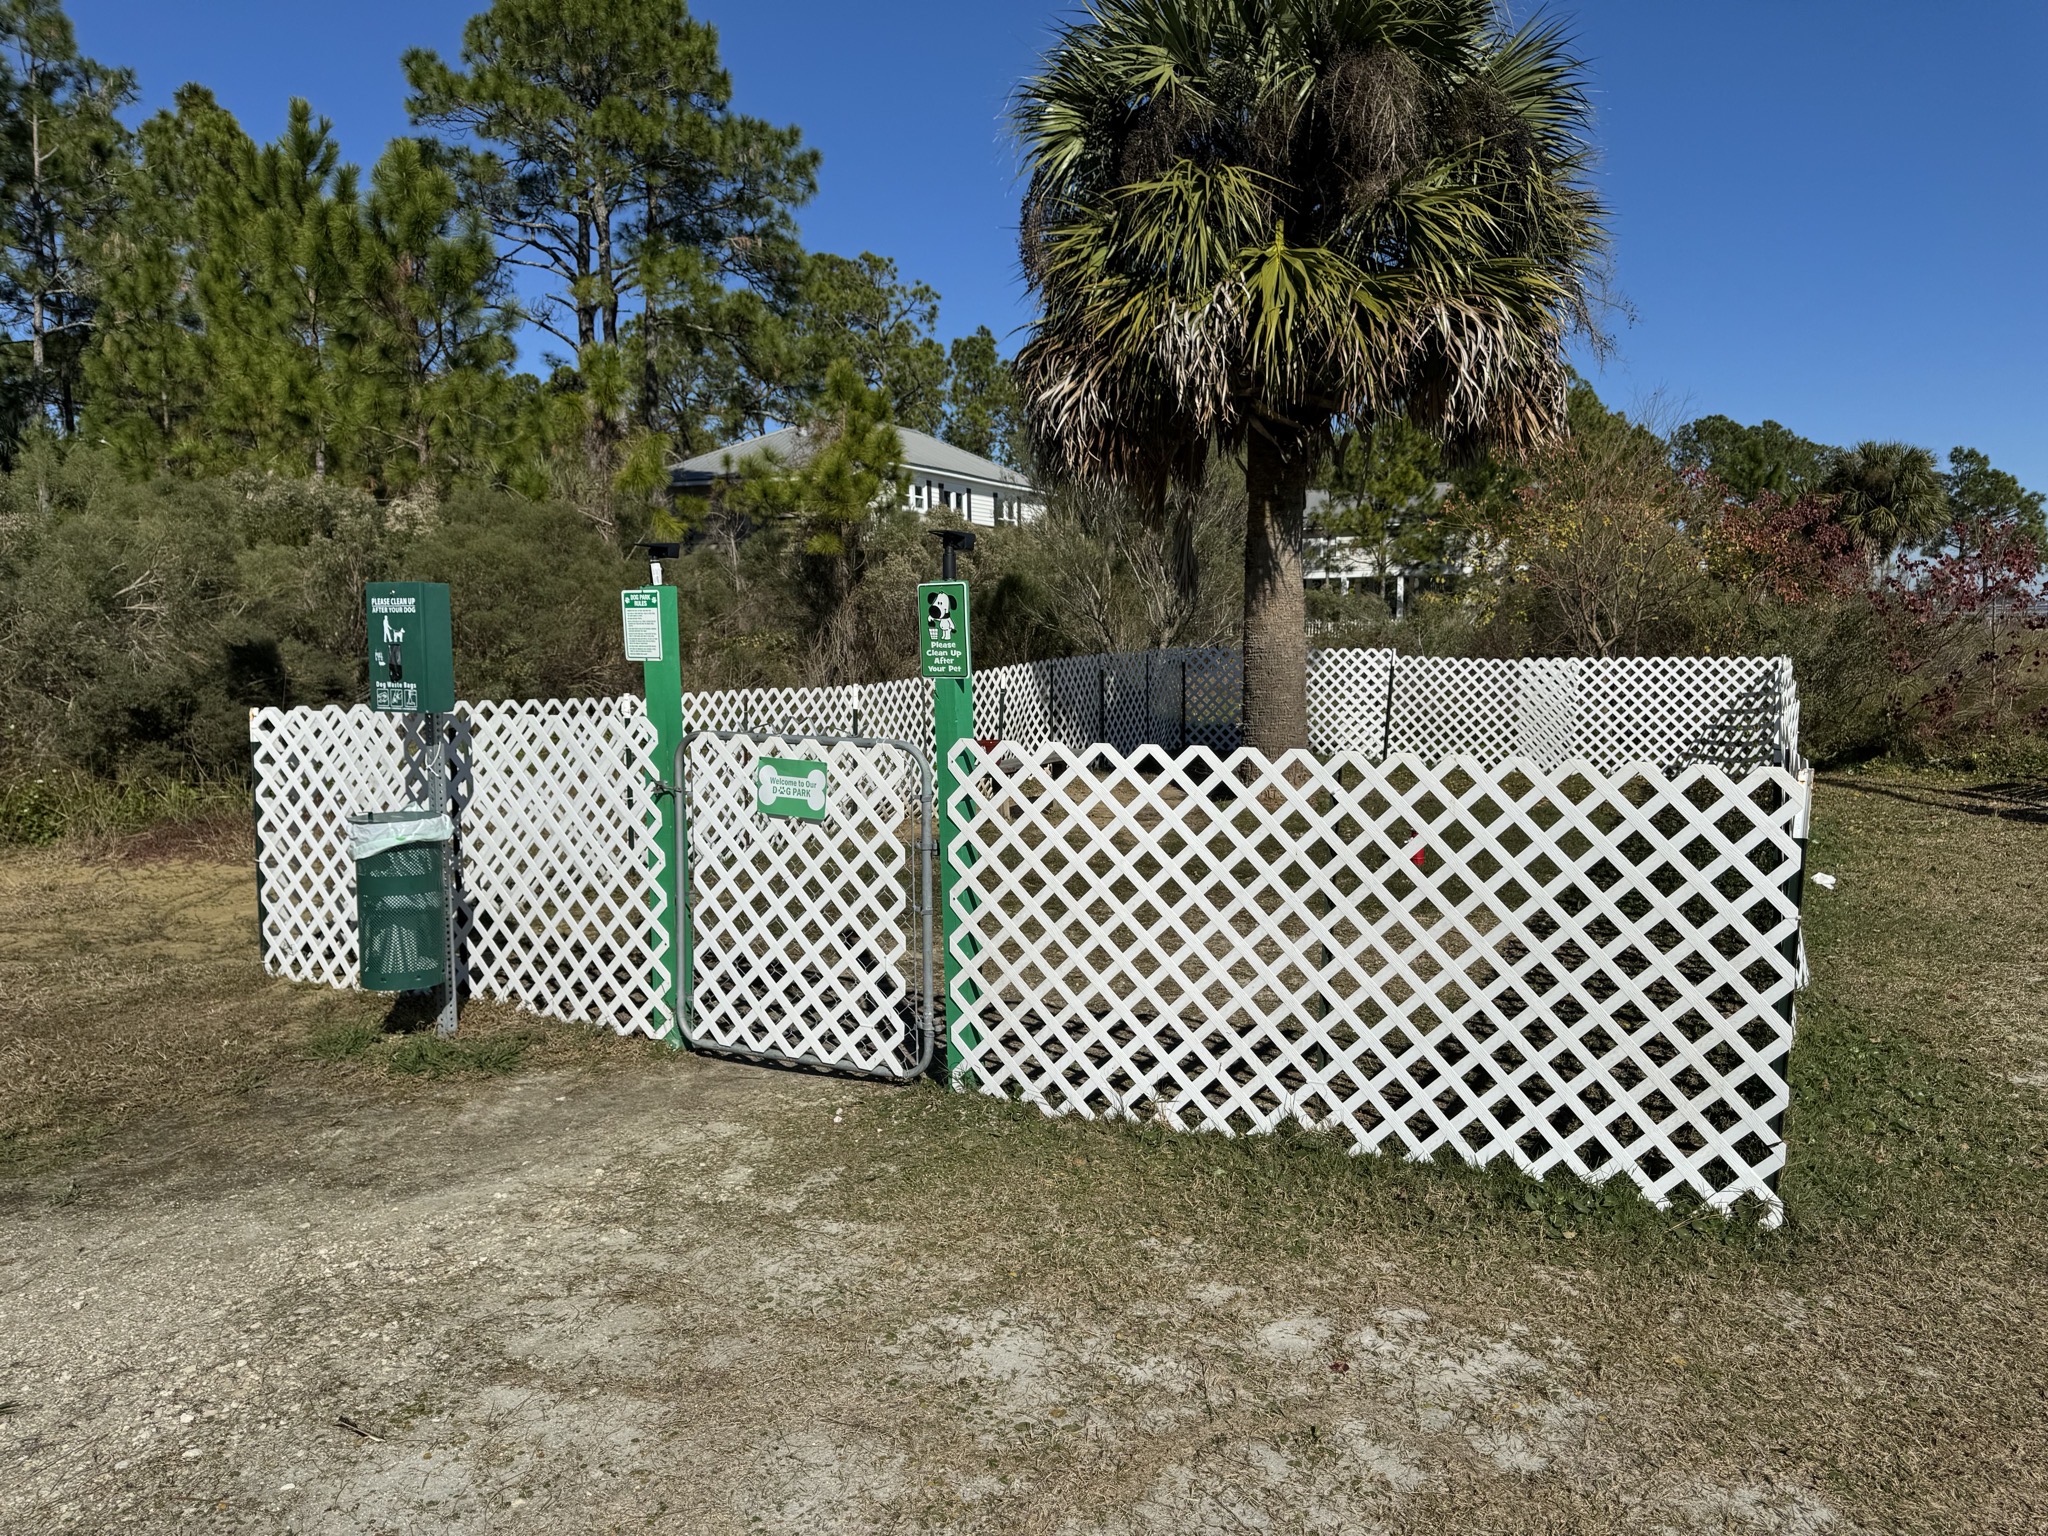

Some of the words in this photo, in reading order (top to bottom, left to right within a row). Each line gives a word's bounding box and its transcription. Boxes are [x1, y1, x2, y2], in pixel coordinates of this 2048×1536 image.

[371, 597, 390, 605] PLEASE
[390, 597, 407, 605] CLEAN
[408, 597, 416, 605] UP
[931, 641, 956, 649] Please
[926, 649, 948, 657] Clean
[950, 650, 962, 658] Up
[934, 656, 955, 665] After
[375, 681, 386, 689] Dog
[403, 682, 417, 690] Bags
[770, 776, 797, 787] Welcome
[805, 780, 817, 789] Our
[792, 787, 811, 798] PARK
